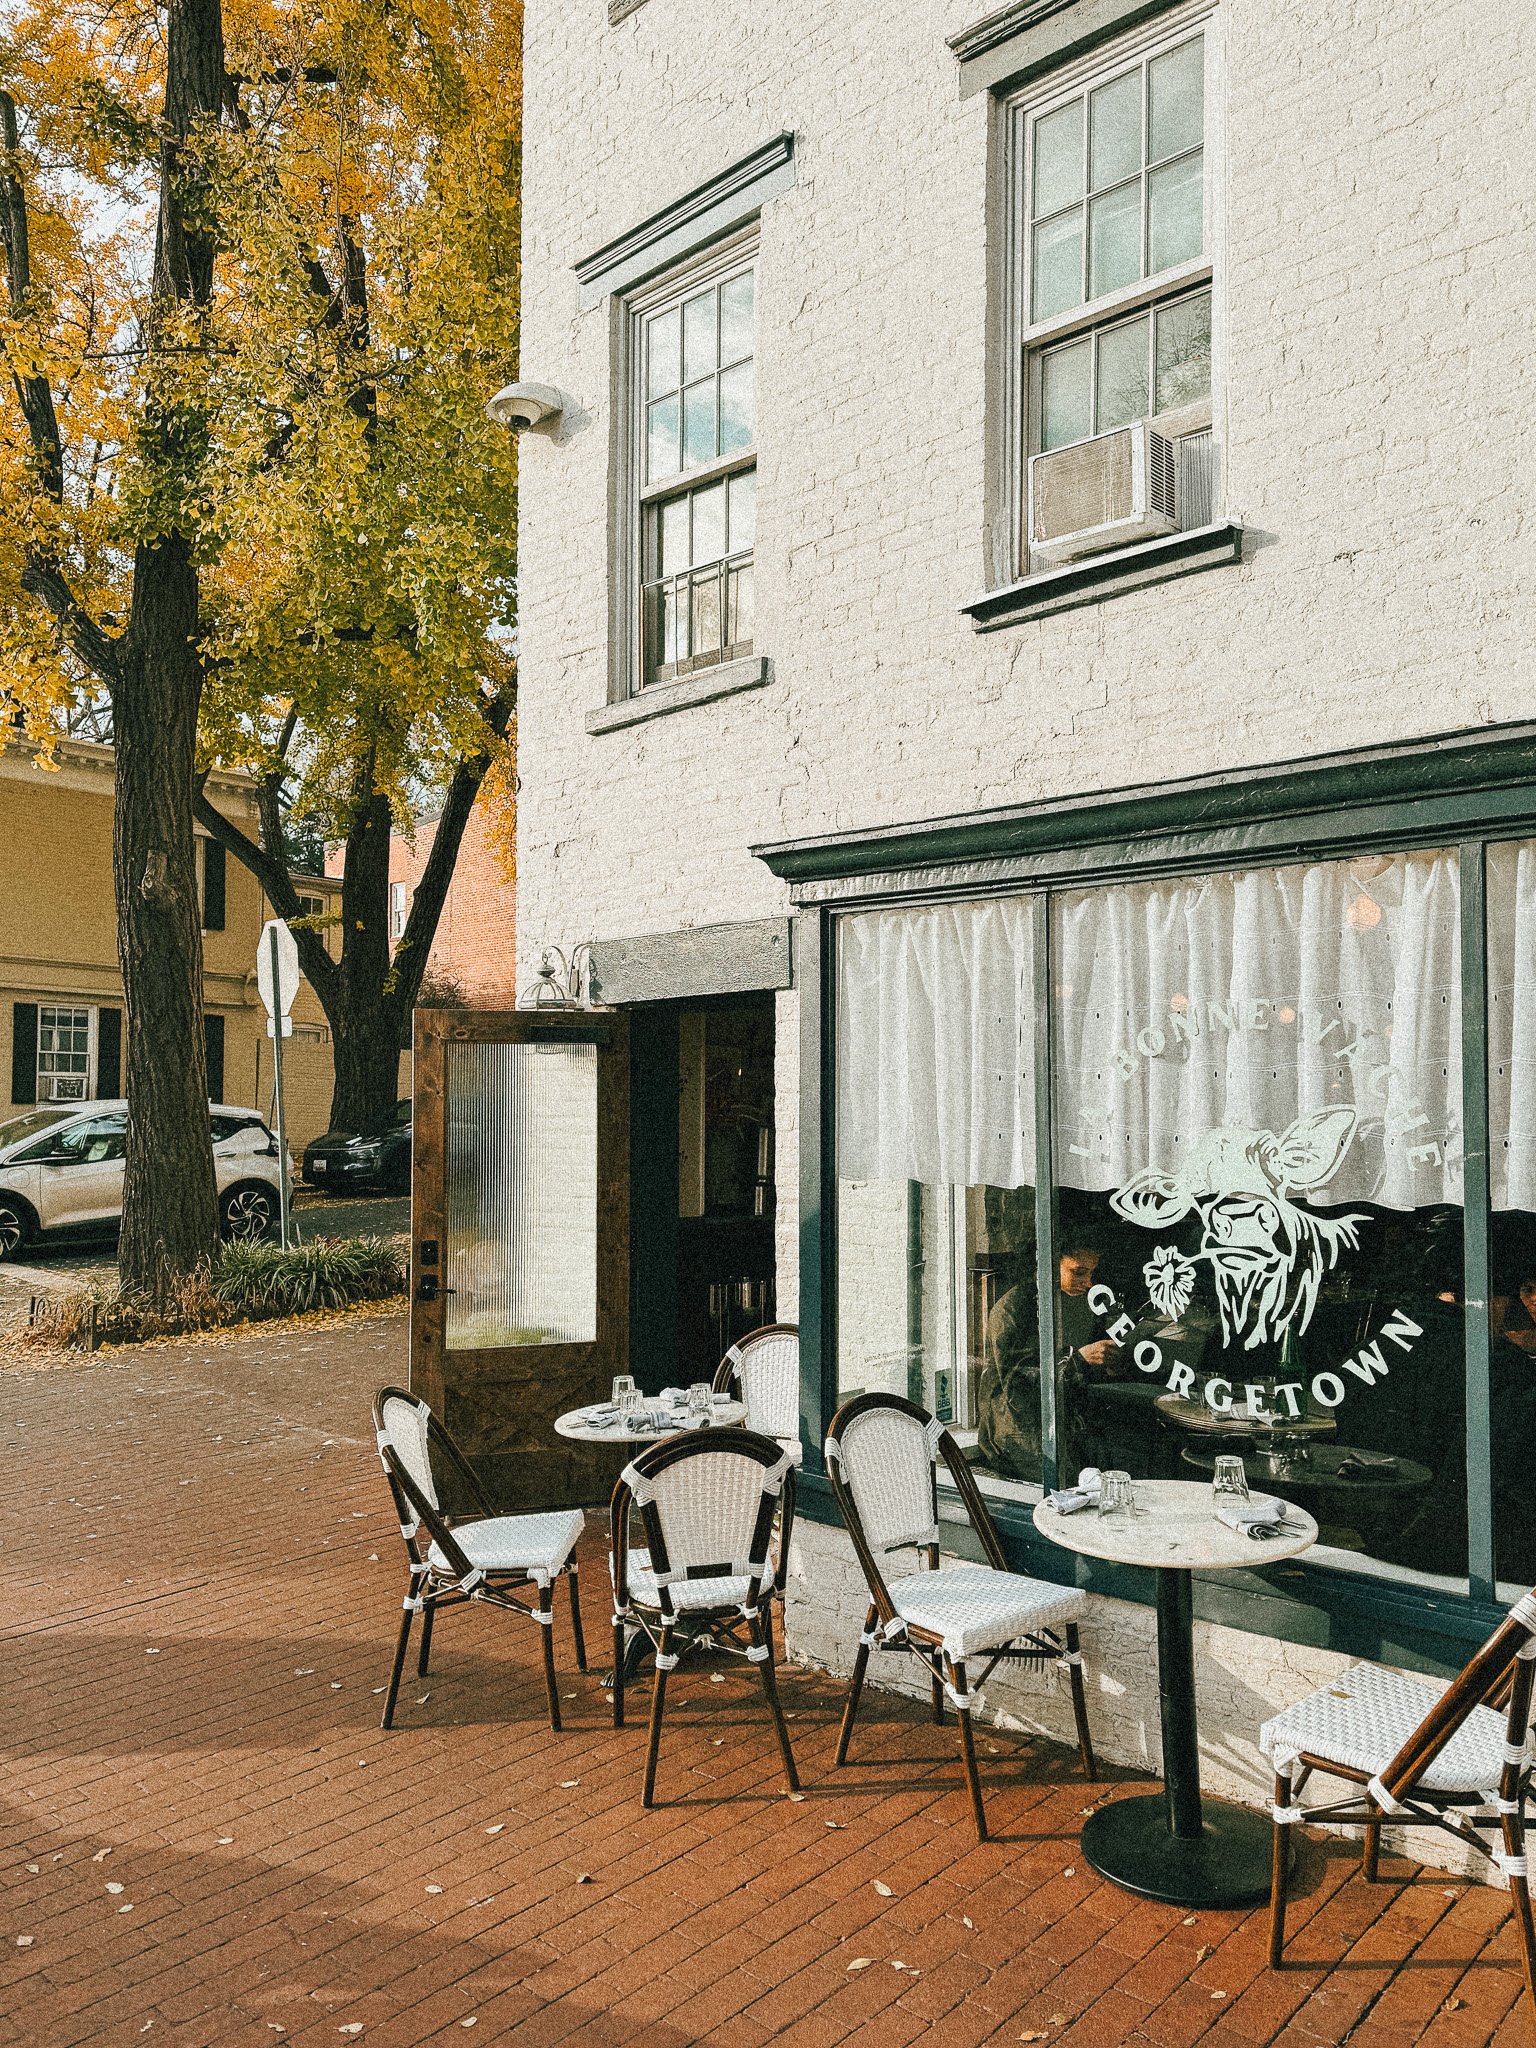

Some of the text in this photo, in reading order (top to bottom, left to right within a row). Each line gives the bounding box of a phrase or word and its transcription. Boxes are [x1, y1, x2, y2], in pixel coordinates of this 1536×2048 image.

[1111, 998, 1271, 1082] BONNE
[1300, 1010, 1443, 1172] VACHE
[937, 1398, 951, 1409] BBB
[1087, 1283, 1425, 1417] GEORGETOWN
